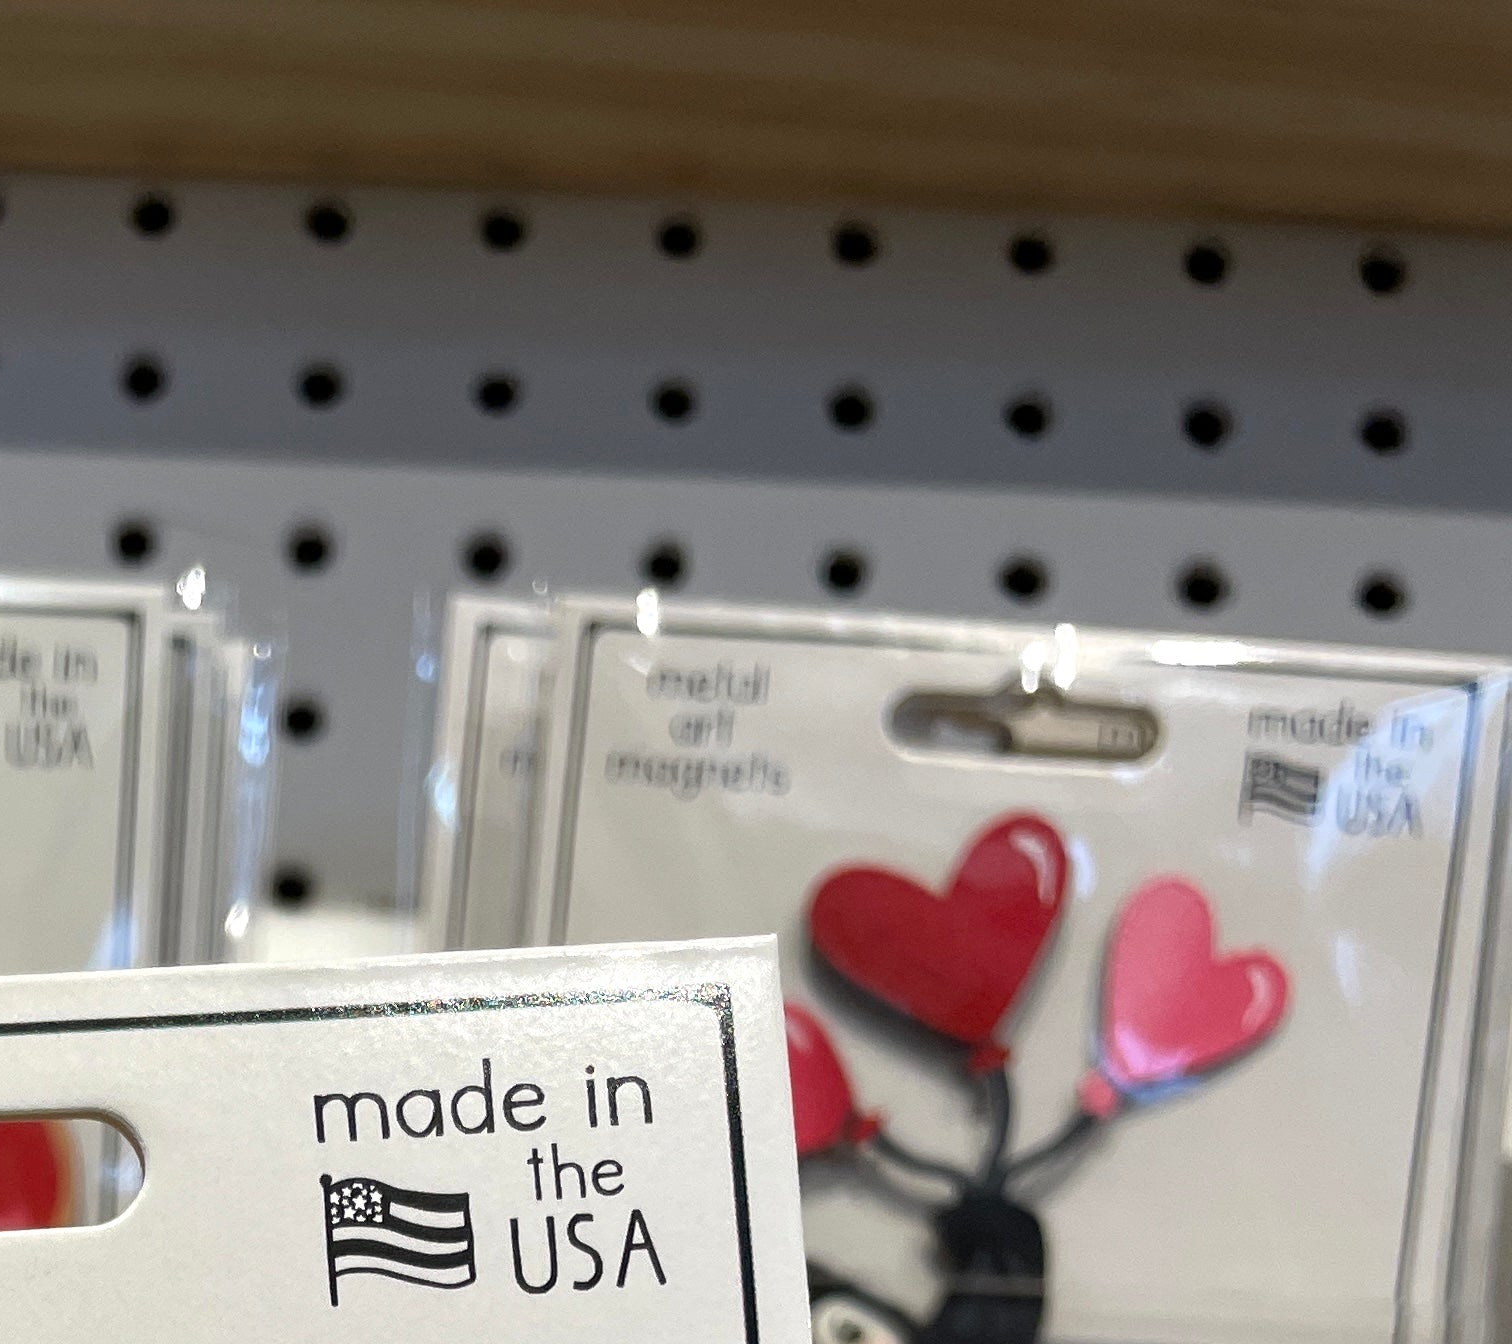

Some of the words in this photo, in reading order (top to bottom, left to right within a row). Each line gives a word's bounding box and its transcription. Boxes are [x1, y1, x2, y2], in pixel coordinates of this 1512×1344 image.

[313, 1057, 548, 1144] made
[585, 1064, 654, 1128] in
[526, 1142, 626, 1201] the
[509, 1207, 668, 1296] USA
